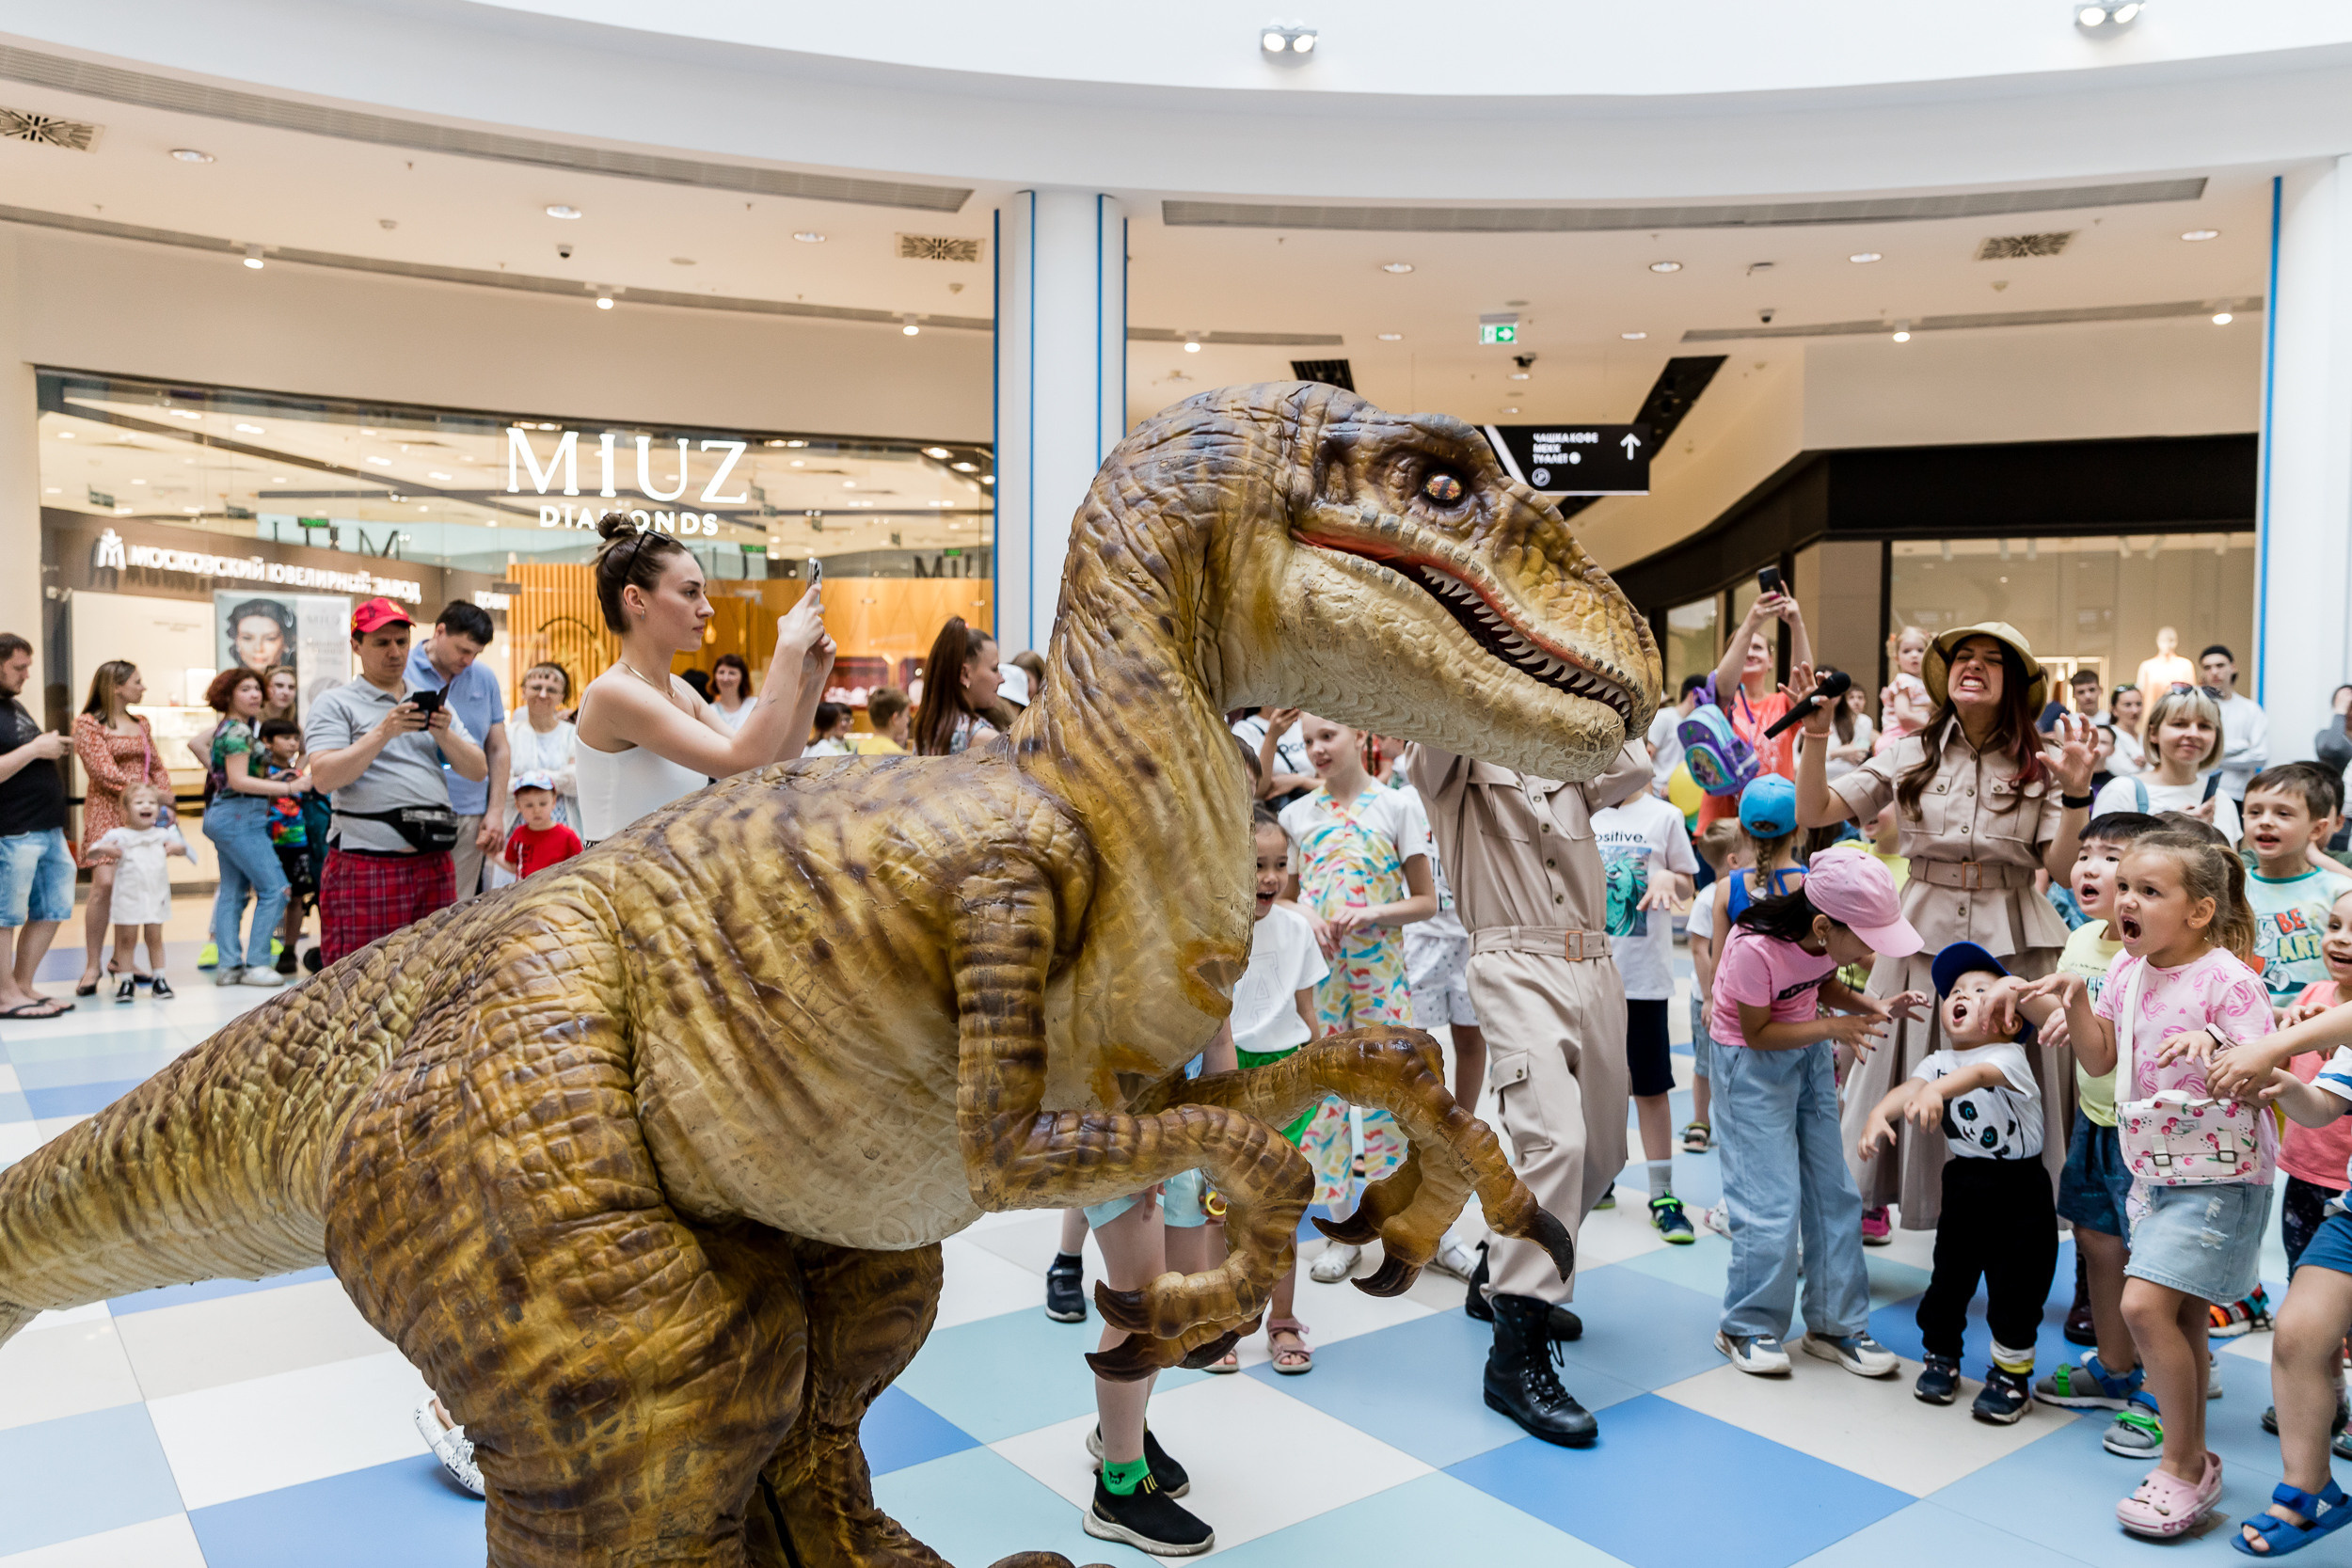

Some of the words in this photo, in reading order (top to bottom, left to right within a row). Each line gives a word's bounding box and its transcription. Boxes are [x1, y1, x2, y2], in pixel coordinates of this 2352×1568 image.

[506, 427, 747, 504] MIUZ
[129, 545, 265, 580] МОСКОВСКИЙ
[1595, 831, 1647, 844] ositive.
[2274, 908, 2307, 935] BE
[2278, 934, 2321, 964] ART
